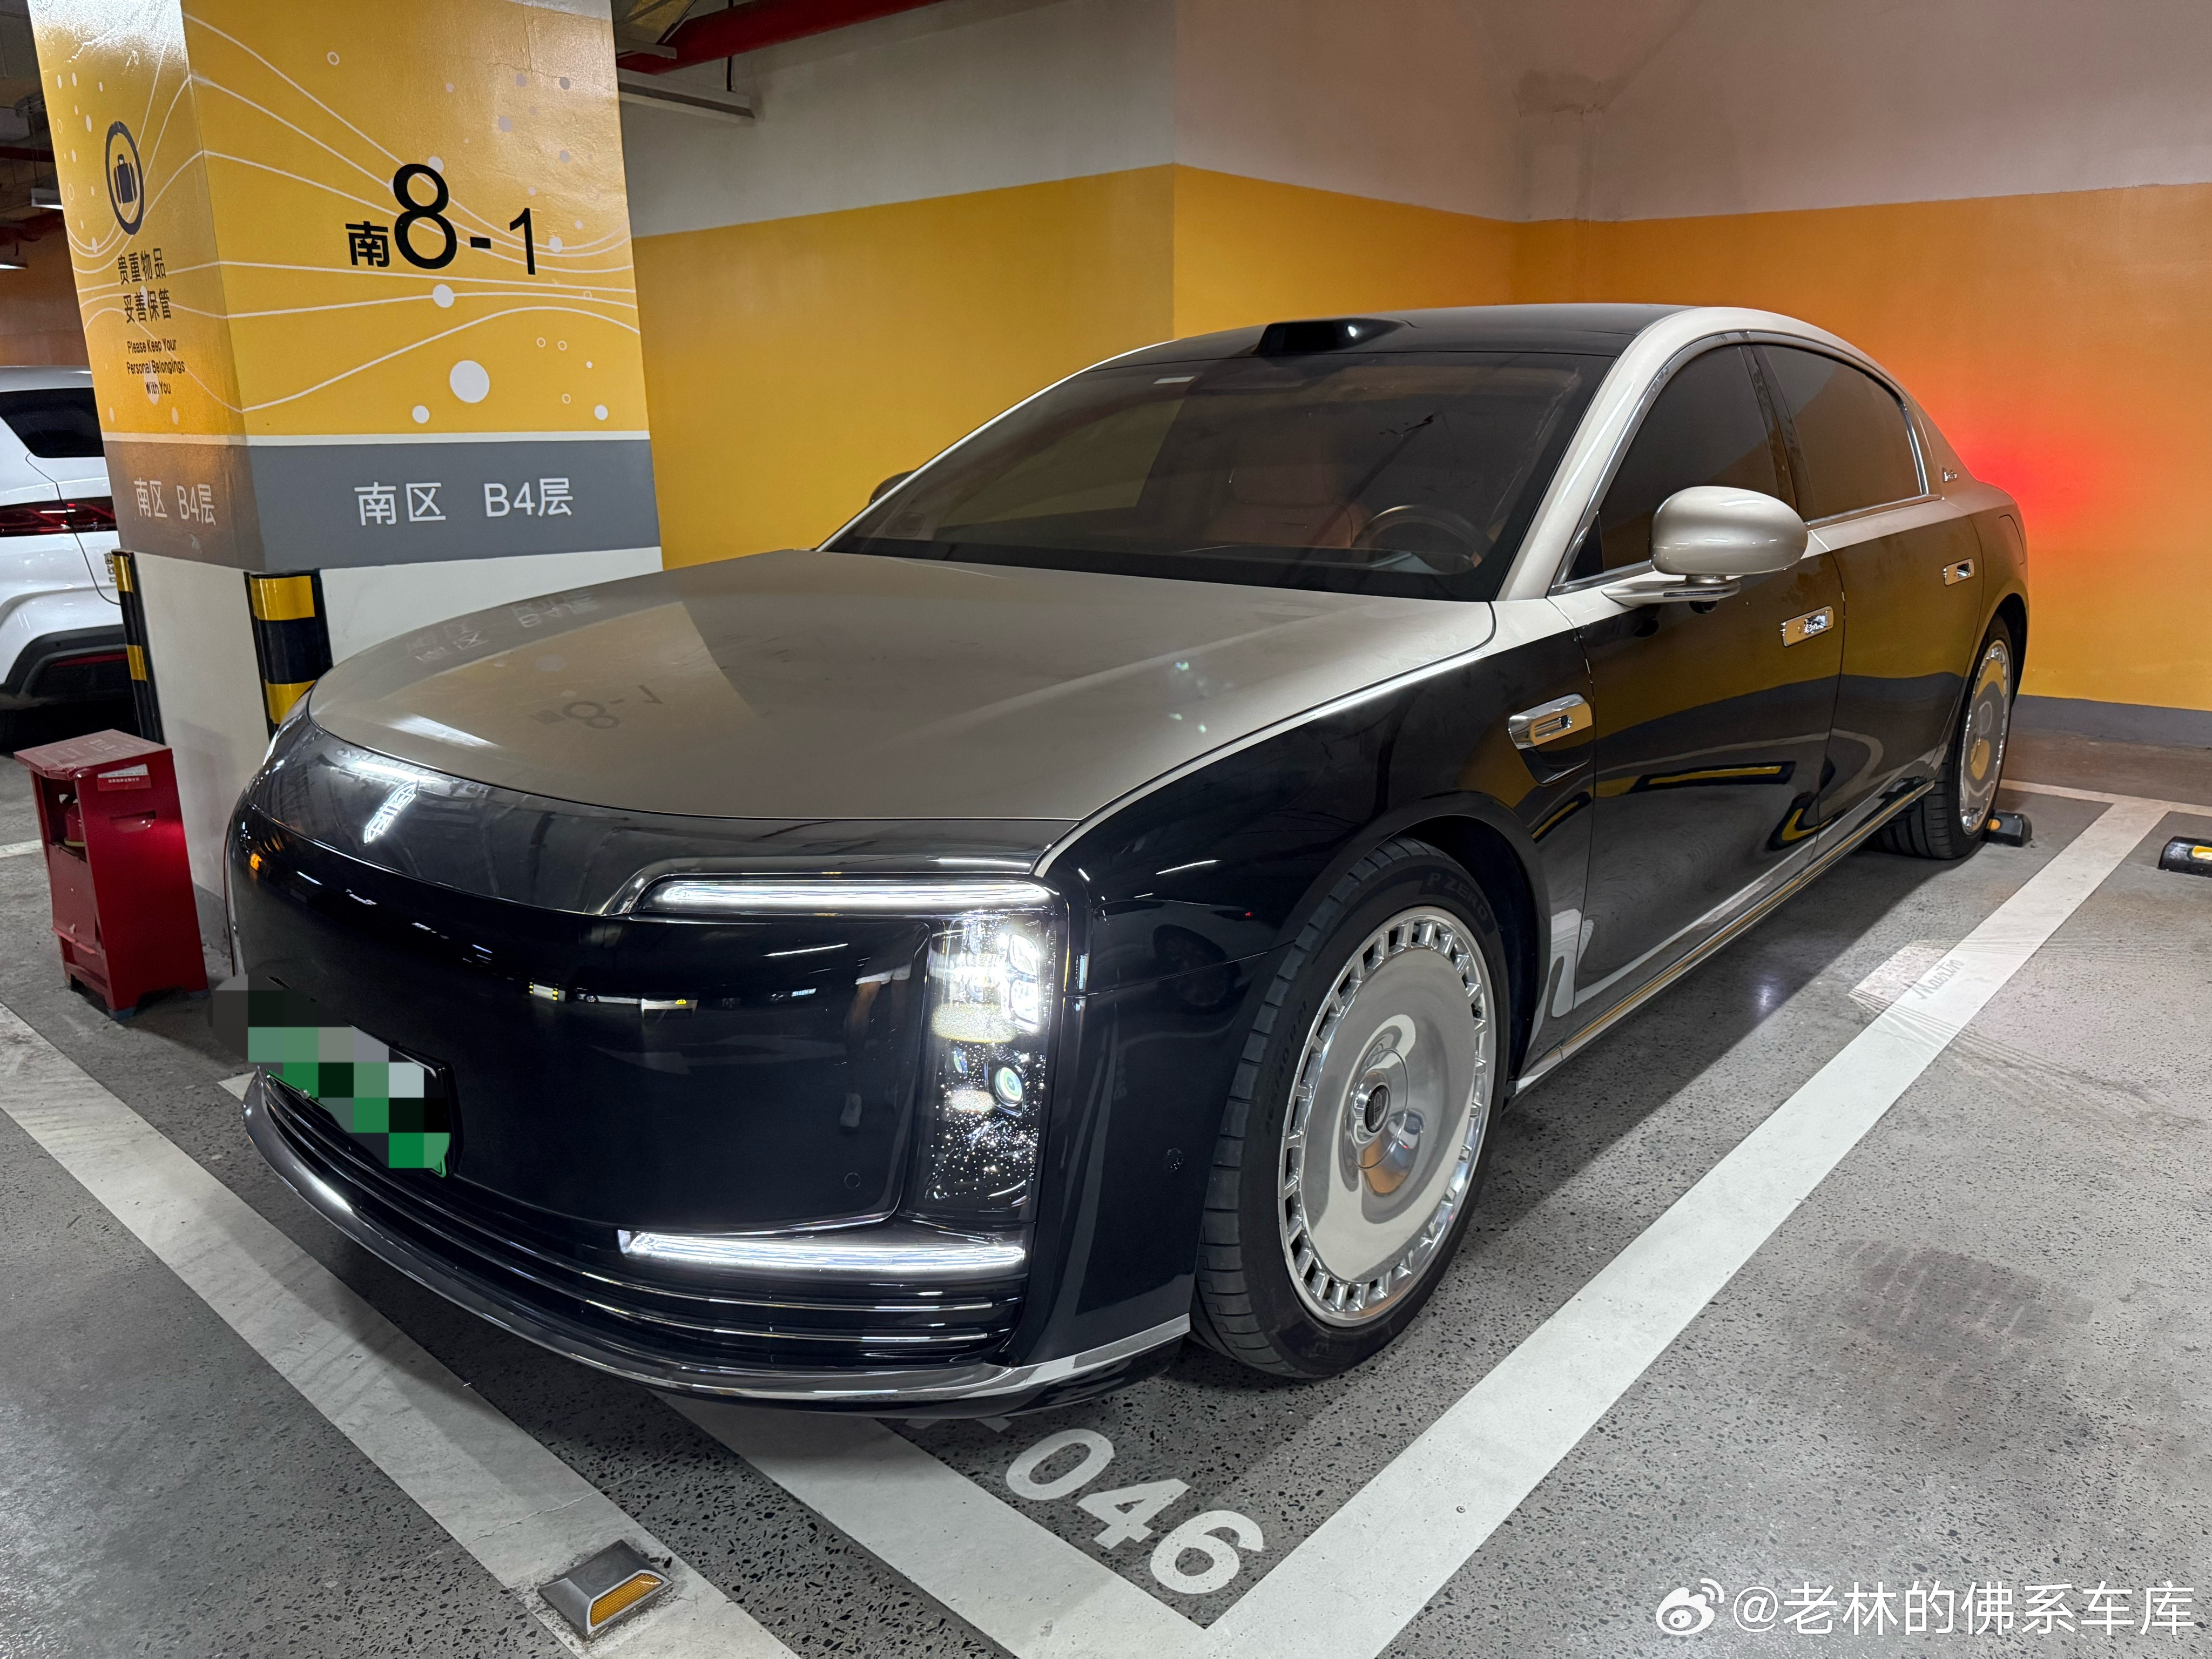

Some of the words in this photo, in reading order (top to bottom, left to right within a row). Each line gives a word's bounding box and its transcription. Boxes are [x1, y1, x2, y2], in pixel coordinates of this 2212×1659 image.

[118, 248, 166, 285] 贵重物品
[123, 288, 171, 323] 妥善保管
[127, 340, 146, 354] Please
[146, 339, 162, 353] Keep
[163, 338, 177, 351] Your
[126, 360, 151, 374] Personal
[151, 359, 185, 374] Belongings
[145, 381, 159, 395] With
[160, 381, 171, 394] You
[134, 476, 167, 517] 南区
[177, 483, 216, 526] B4层
[354, 481, 447, 527] 南区
[484, 477, 574, 517] B4层
[1444, 876, 1488, 921] ZERO
[905, 1417, 1264, 1594] 046
